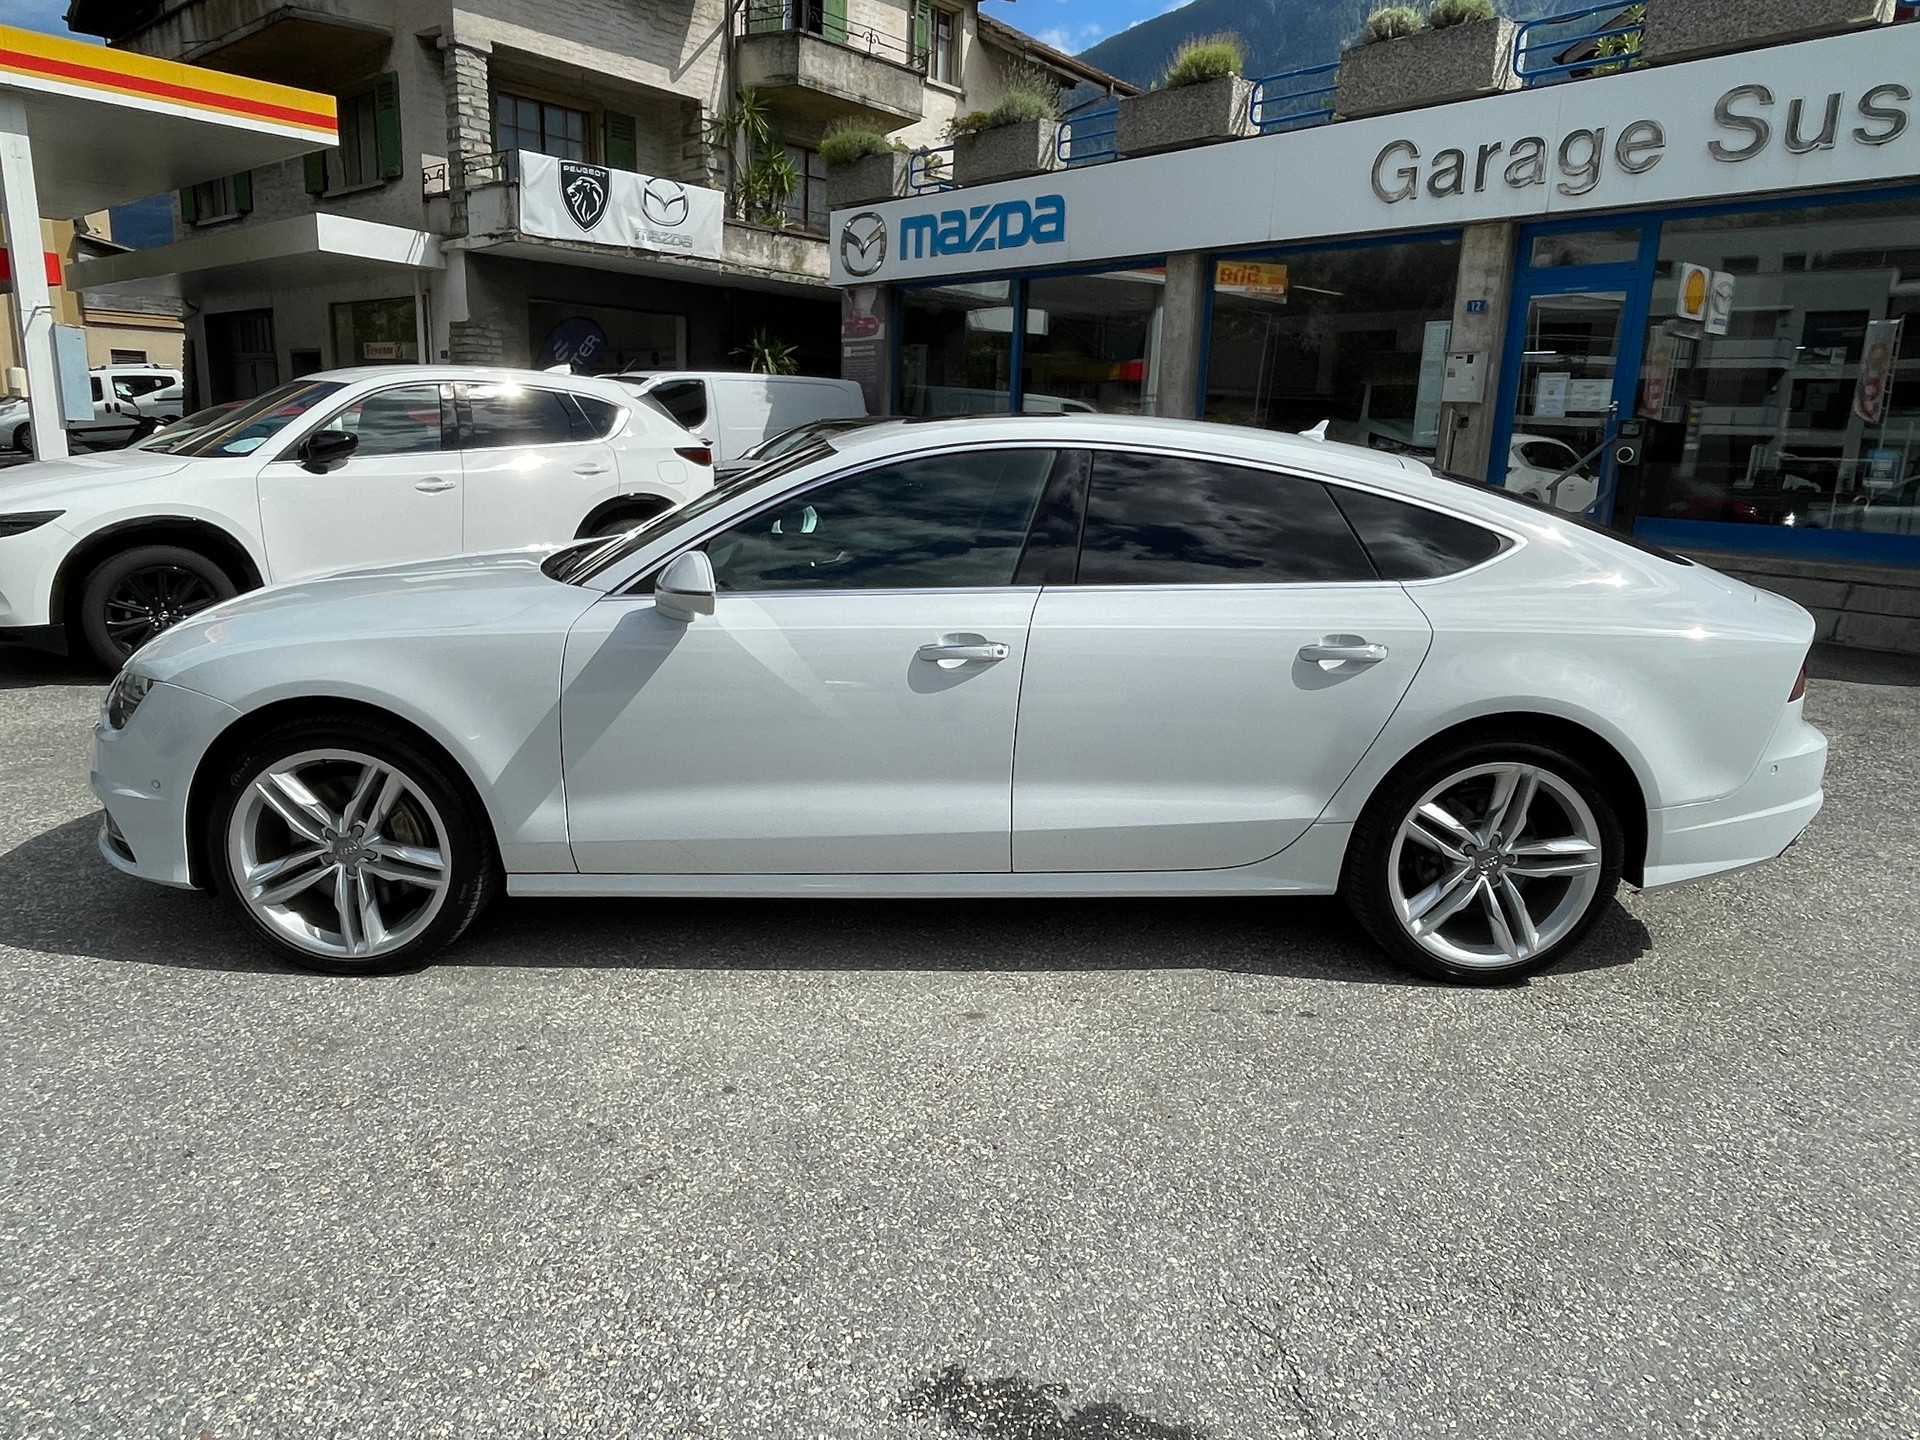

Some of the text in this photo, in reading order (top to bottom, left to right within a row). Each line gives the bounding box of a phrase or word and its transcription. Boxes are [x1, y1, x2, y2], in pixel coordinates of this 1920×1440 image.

[1371, 83, 1912, 204] Garage Sus
[563, 165, 607, 178] PEUGEOT
[1471, 301, 1482, 312] 12
